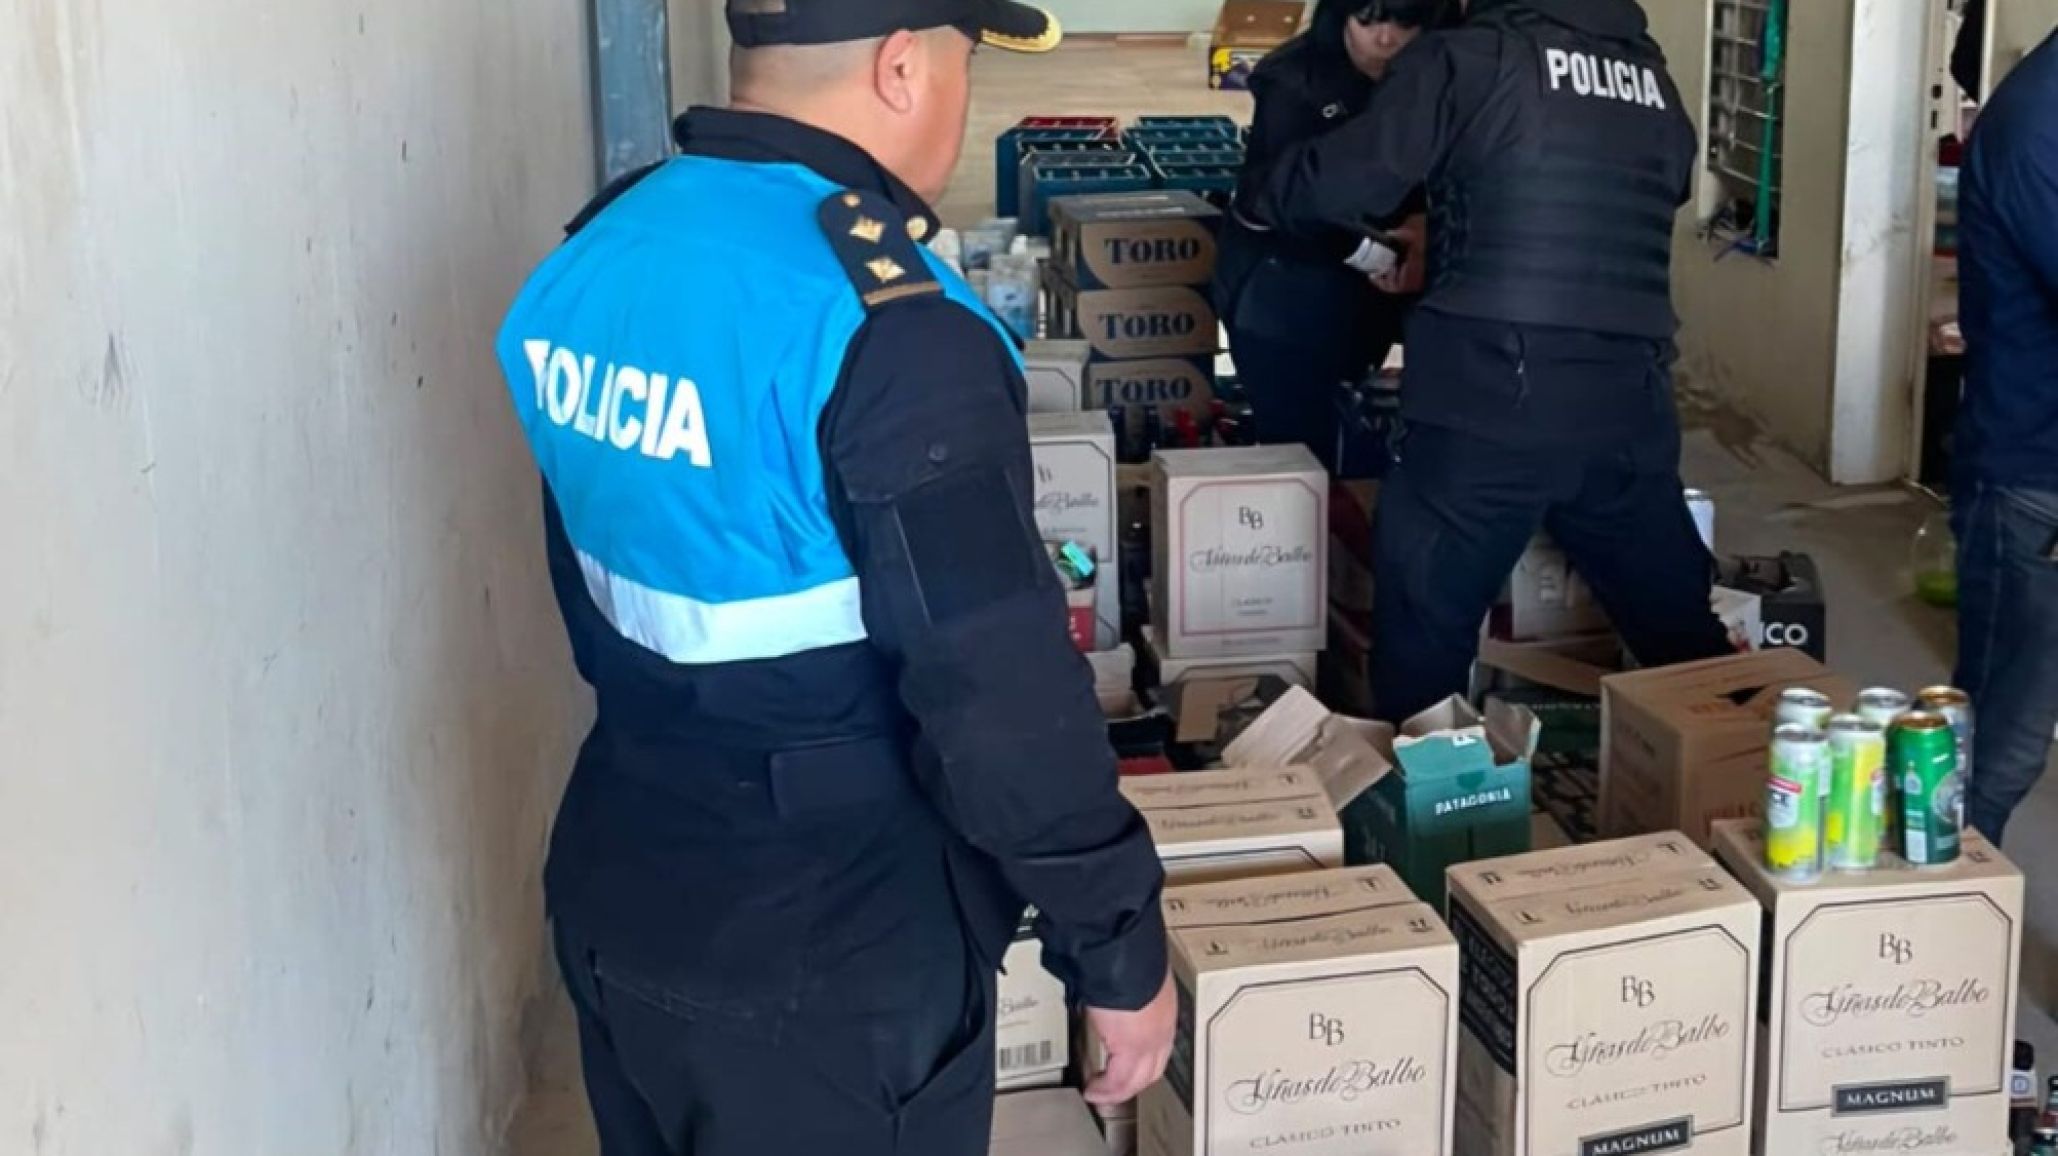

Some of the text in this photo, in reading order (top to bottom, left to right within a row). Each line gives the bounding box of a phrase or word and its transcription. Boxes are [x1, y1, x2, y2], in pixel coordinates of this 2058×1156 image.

[1546, 48, 1665, 110] POLICIA
[1105, 236, 1200, 265] TORO
[1099, 311, 1195, 340] TORO
[1096, 377, 1192, 403] TORO
[1878, 932, 1913, 965] BB
[1622, 974, 1657, 1008] BB
[1308, 1012, 1345, 1046] BB
[1846, 1086, 1936, 1106] MAGNUM
[1592, 1128, 1681, 1154] MAGNUM
